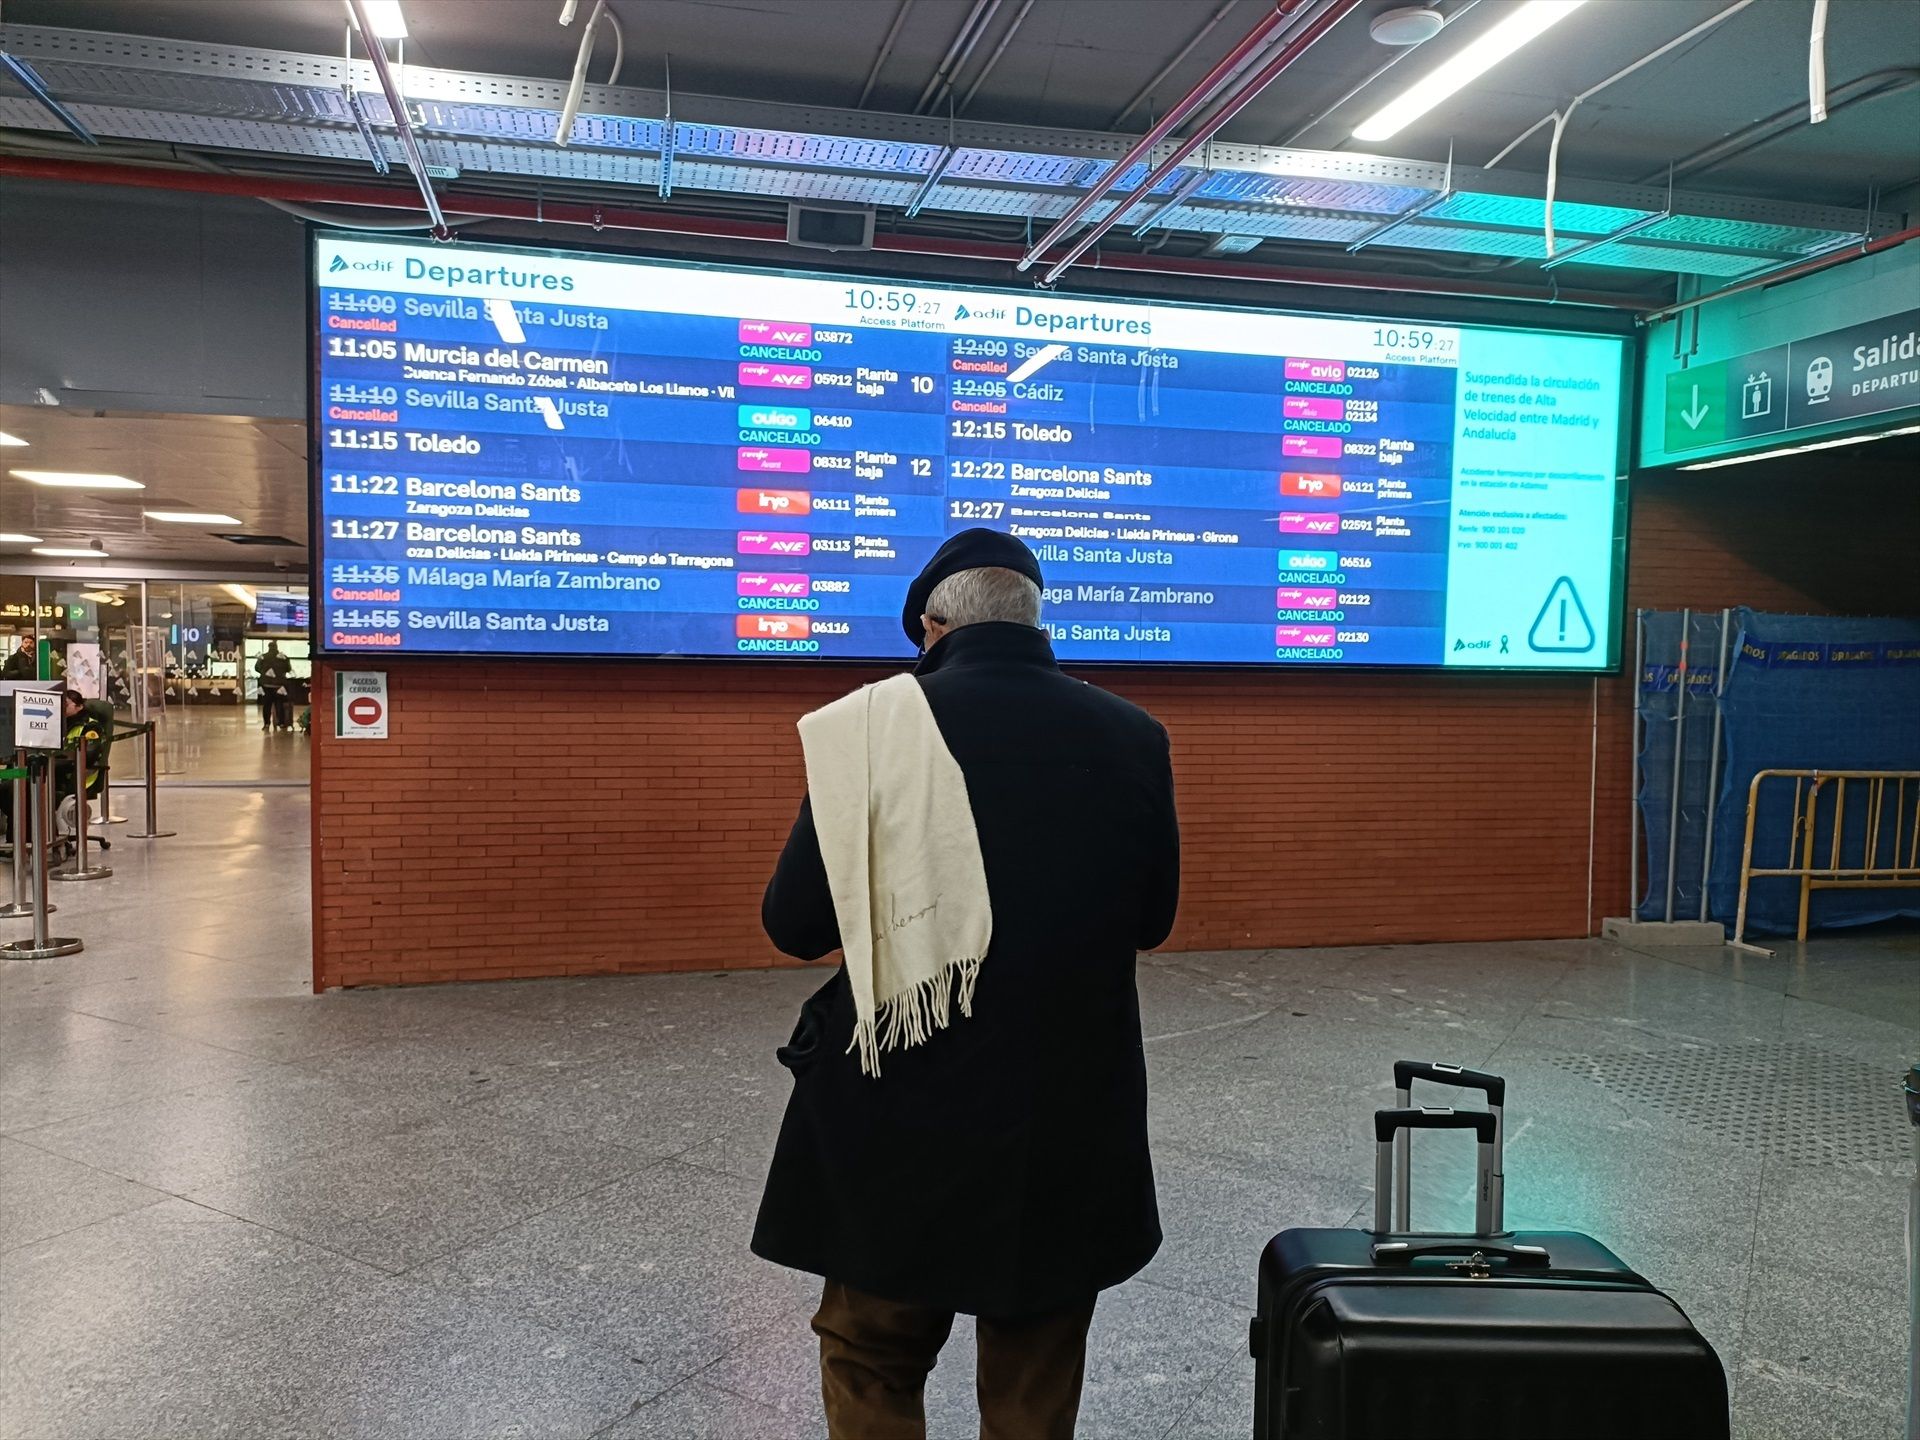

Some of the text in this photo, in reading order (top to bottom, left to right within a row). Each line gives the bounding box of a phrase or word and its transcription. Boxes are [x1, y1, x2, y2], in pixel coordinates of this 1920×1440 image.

[353, 258, 395, 272] adif
[406, 258, 574, 291] Departures
[329, 292, 609, 329] 11:00 Sevilla Justa
[974, 309, 1007, 319] adif
[329, 316, 396, 332] Cancelled
[860, 316, 945, 330] Access Platform
[1016, 307, 1151, 334] Departures
[771, 330, 853, 344] AVE 03872
[329, 338, 608, 374] 11:05 Murcia del Carmen
[740, 345, 822, 362] CANCELADO
[954, 338, 1178, 369] 12:00 Santa Justa
[1385, 352, 1456, 365] Access Platform
[953, 359, 1007, 373] Cancelled
[1347, 367, 1379, 378] 02126
[459, 369, 664, 394] Fernando Zóbel Albacete Los
[771, 367, 933, 394] AVE 05912 Planta 10
[1285, 381, 1352, 395] CANCELADO
[1466, 372, 1600, 390] Suspendida la circulación
[330, 384, 478, 410] 11:10 Sevilla
[856, 382, 885, 397] baja
[953, 379, 1064, 401] 12:05 Cádiz
[1346, 400, 1378, 411] 02124
[1465, 390, 1556, 406] de trenes de Alta
[330, 406, 397, 422] Cancelled
[952, 400, 1007, 414] Cancelled
[814, 415, 852, 428] 06410
[1346, 411, 1377, 422] 02134
[1464, 409, 1599, 429] Velocidad entre Madrid y
[952, 420, 1072, 442] 12:15 Toledo
[1284, 420, 1351, 433] CANCELADO
[330, 429, 481, 454] 11:15 Toledo
[739, 429, 821, 445] CANCELADO
[1380, 439, 1414, 451] Planta
[855, 451, 931, 476] Planta 12
[1379, 452, 1402, 465] baja
[855, 464, 883, 480] baja
[952, 460, 1151, 486] 12:22 Barcelona Sants
[331, 474, 580, 503] 11:22 Barcelona Sants
[1011, 485, 1110, 500] Zaragoza Delicias
[1343, 478, 1406, 492] 06121 Planta
[406, 501, 529, 518] Zaragoza Delicias
[813, 498, 851, 511] 06111
[855, 494, 889, 507] Planta
[855, 505, 896, 518] primera
[951, 501, 1151, 521] 12:27 Barcelona Sants
[1459, 509, 1490, 517] Atención
[1306, 516, 1405, 531] AVE 02591 Planta
[331, 520, 580, 546] 11:27 Barcelona Sants
[1010, 524, 1238, 543] Zaragoza Delicias Girona
[770, 536, 888, 552] AVE 03113 Planta
[407, 547, 734, 569] oza Delicias Lleida Pirineus Camp de Tarragona
[854, 547, 896, 560] primera
[1073, 546, 1172, 565] Santa Justa
[1340, 557, 1371, 568] 06516
[332, 565, 660, 591] 11:35 Málaga María Zambrano
[1279, 573, 1345, 584] CANCELADO
[332, 588, 400, 601] Cancelled
[770, 583, 804, 594] AVE
[1078, 585, 1214, 605] María Zambrano
[738, 598, 819, 611] CANCELADO
[1304, 594, 1370, 607] AVE 02122
[332, 609, 609, 632] 11:55 Sevilla Santa Justa
[1278, 610, 1344, 621] CANCELADO
[182, 628, 200, 642] 10
[812, 621, 849, 634] 06116
[1071, 625, 1170, 642] Santa Justa
[332, 632, 400, 646] Cancelled
[738, 640, 819, 652] CANCELADO
[1303, 634, 1332, 644] AVE
[1468, 640, 1492, 650] adif
[1277, 648, 1343, 659] CANCELADO
[23, 696, 53, 705] SALIDA
[30, 721, 48, 729] EXIT
